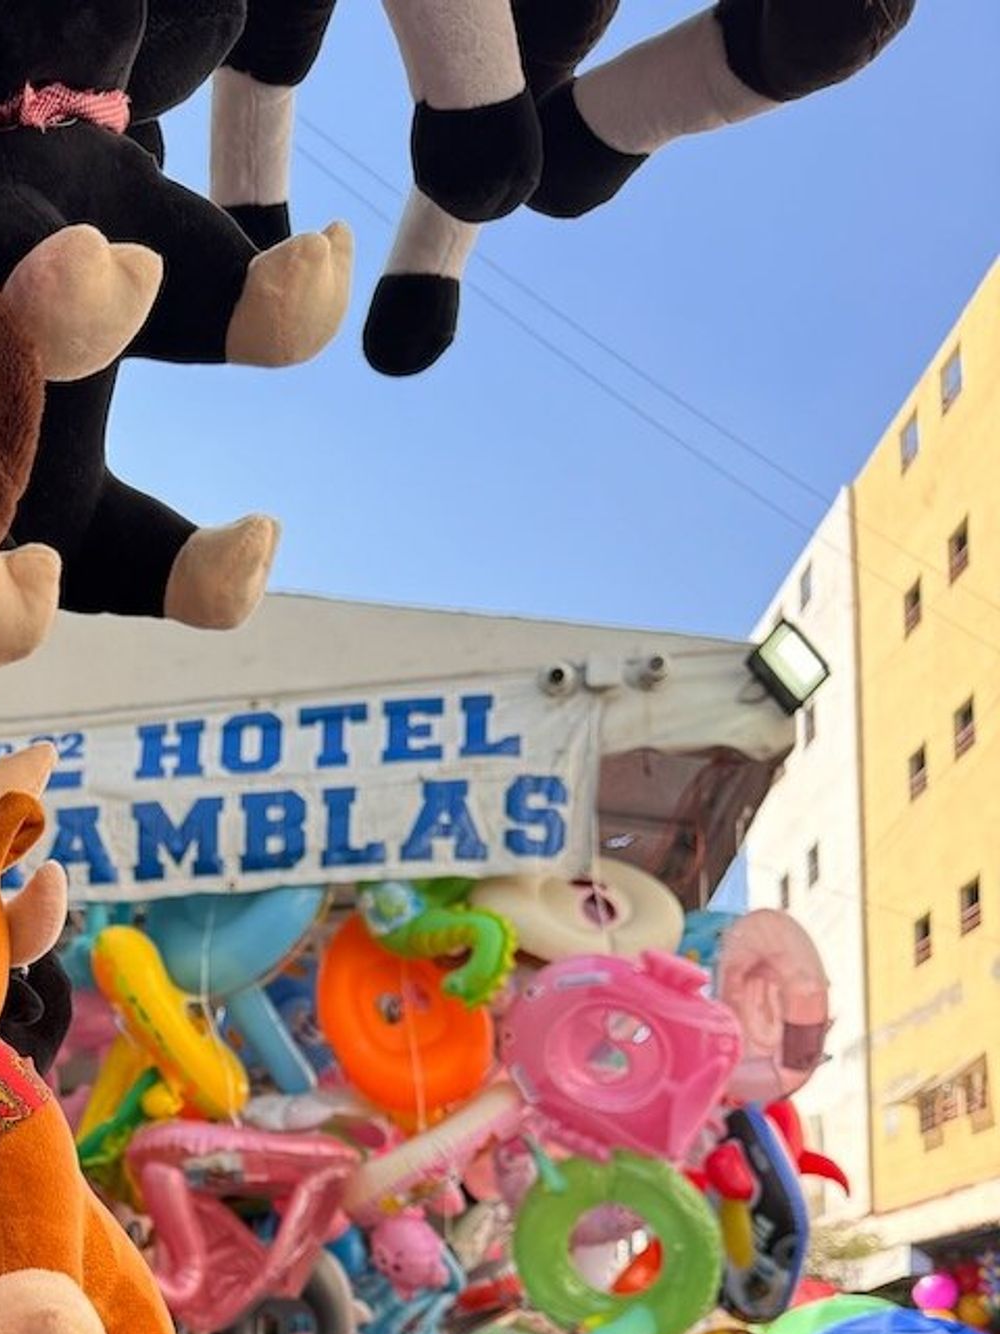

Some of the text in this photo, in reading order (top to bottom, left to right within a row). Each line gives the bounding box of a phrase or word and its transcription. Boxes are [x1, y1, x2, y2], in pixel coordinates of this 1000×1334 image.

[30, 732, 85, 759] 2
[135, 695, 521, 780] HOTEL
[0, 775, 569, 888] AMBLAS
